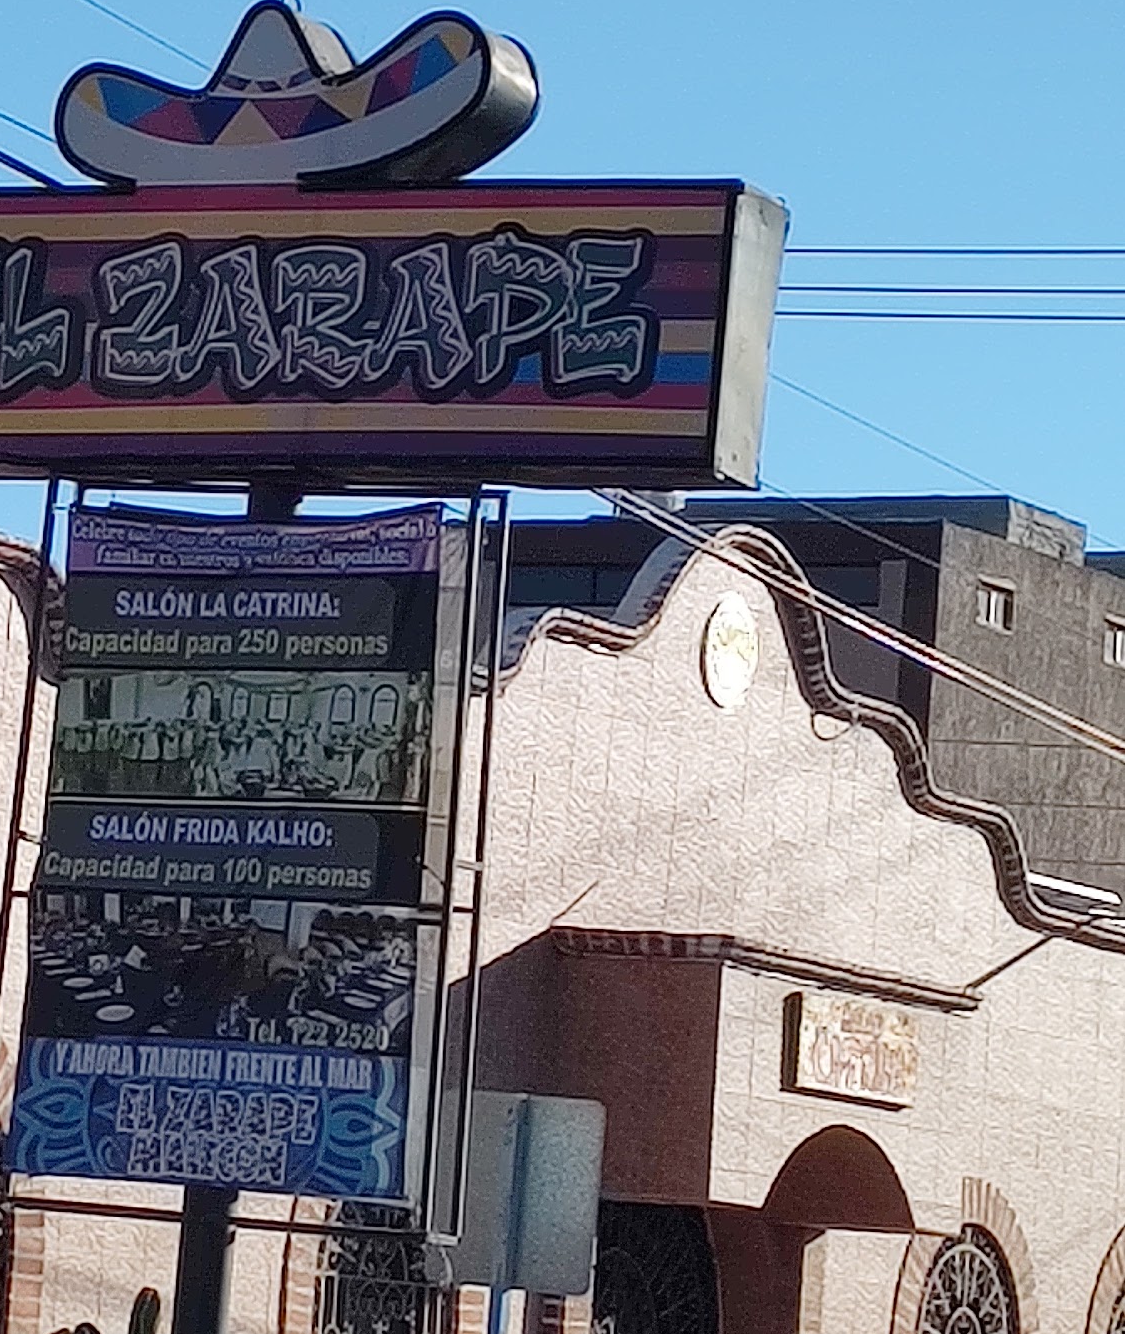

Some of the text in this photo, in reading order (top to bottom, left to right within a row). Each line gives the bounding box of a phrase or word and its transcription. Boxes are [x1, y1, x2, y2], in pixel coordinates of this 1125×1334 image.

[97, 234, 647, 393] ZARAPE
[114, 585, 341, 618] SALÓN LA CATRINA:
[65, 626, 389, 661] Capacidad para 250 personas
[89, 810, 335, 847] SALÓN FRIDA KALHO:
[43, 851, 373, 890] Capacidad para 100 personas
[246, 1016, 283, 1046] Tel.
[334, 1021, 390, 1052] 2520
[56, 1041, 373, 1090] Y AHORA TAMBIEN FRENTE AL MAR
